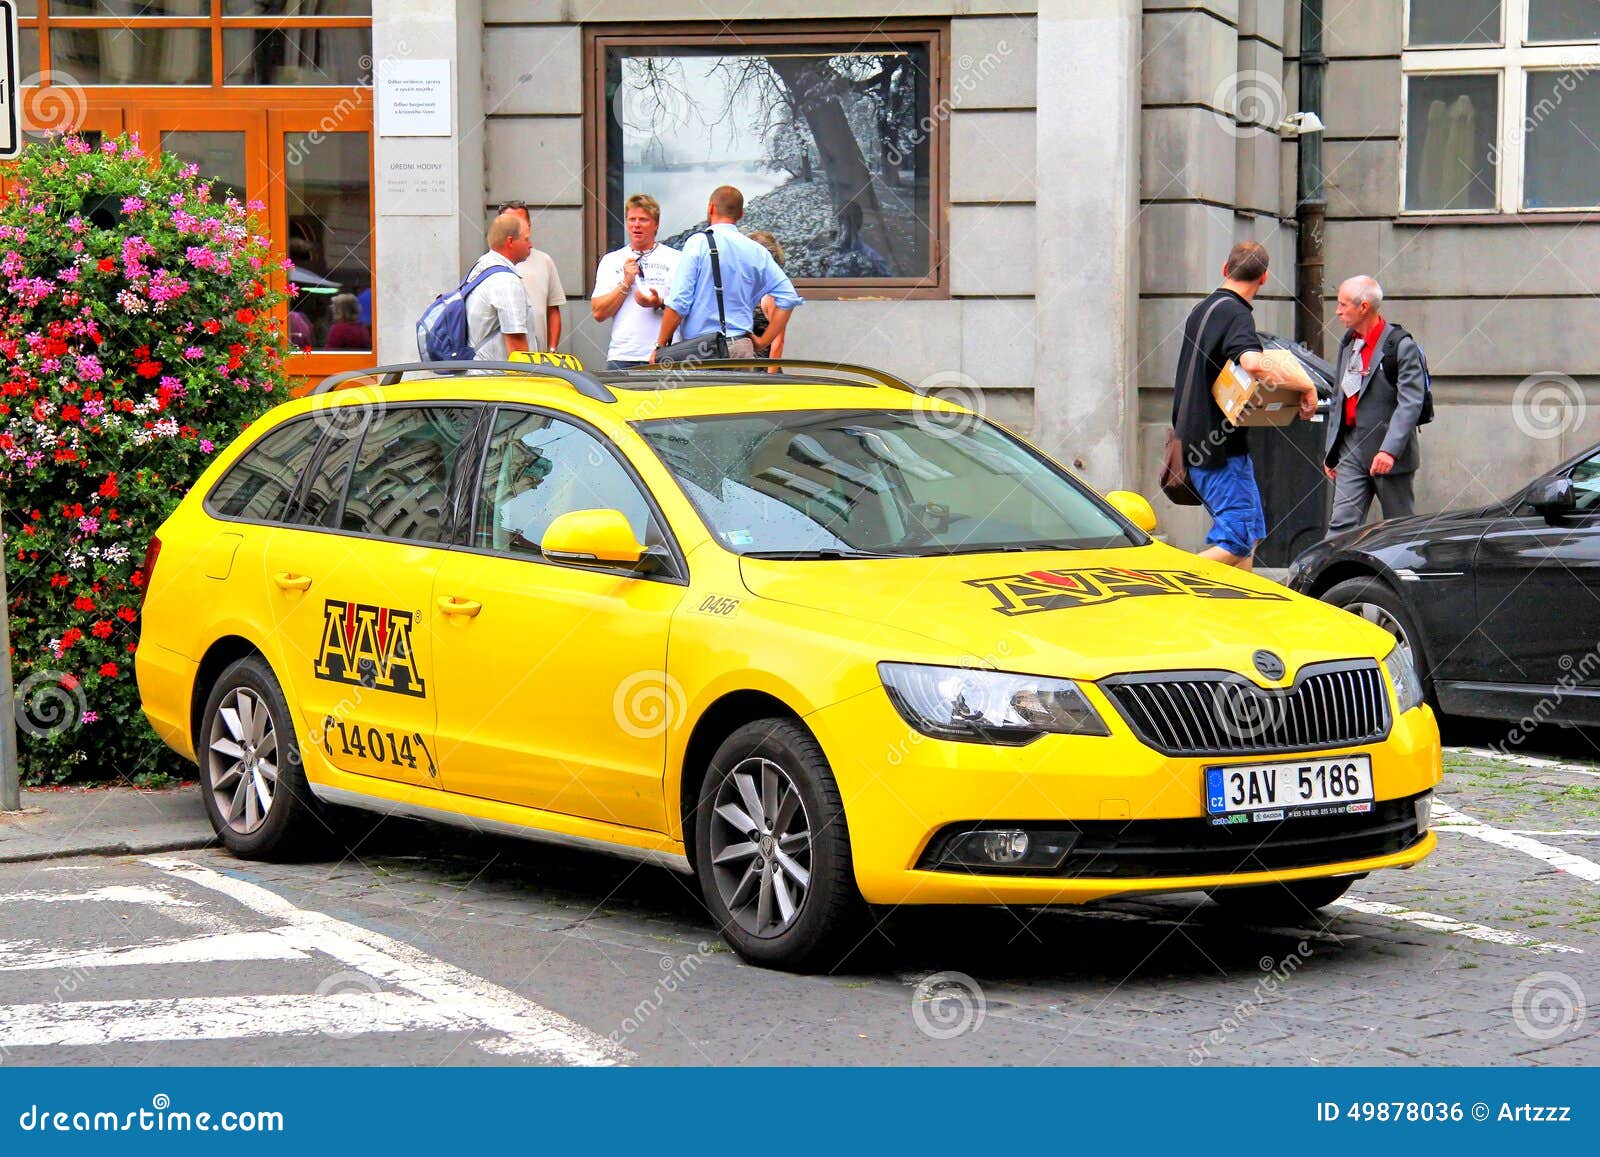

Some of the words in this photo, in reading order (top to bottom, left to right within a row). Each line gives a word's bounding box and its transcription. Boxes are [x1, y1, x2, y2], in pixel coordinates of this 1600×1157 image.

[520, 352, 580, 372] TAXI
[699, 595, 740, 615] 0456
[1230, 769, 1277, 805] 3AV
[1298, 763, 1360, 800] 5186
[1211, 797, 1224, 808] CZ
